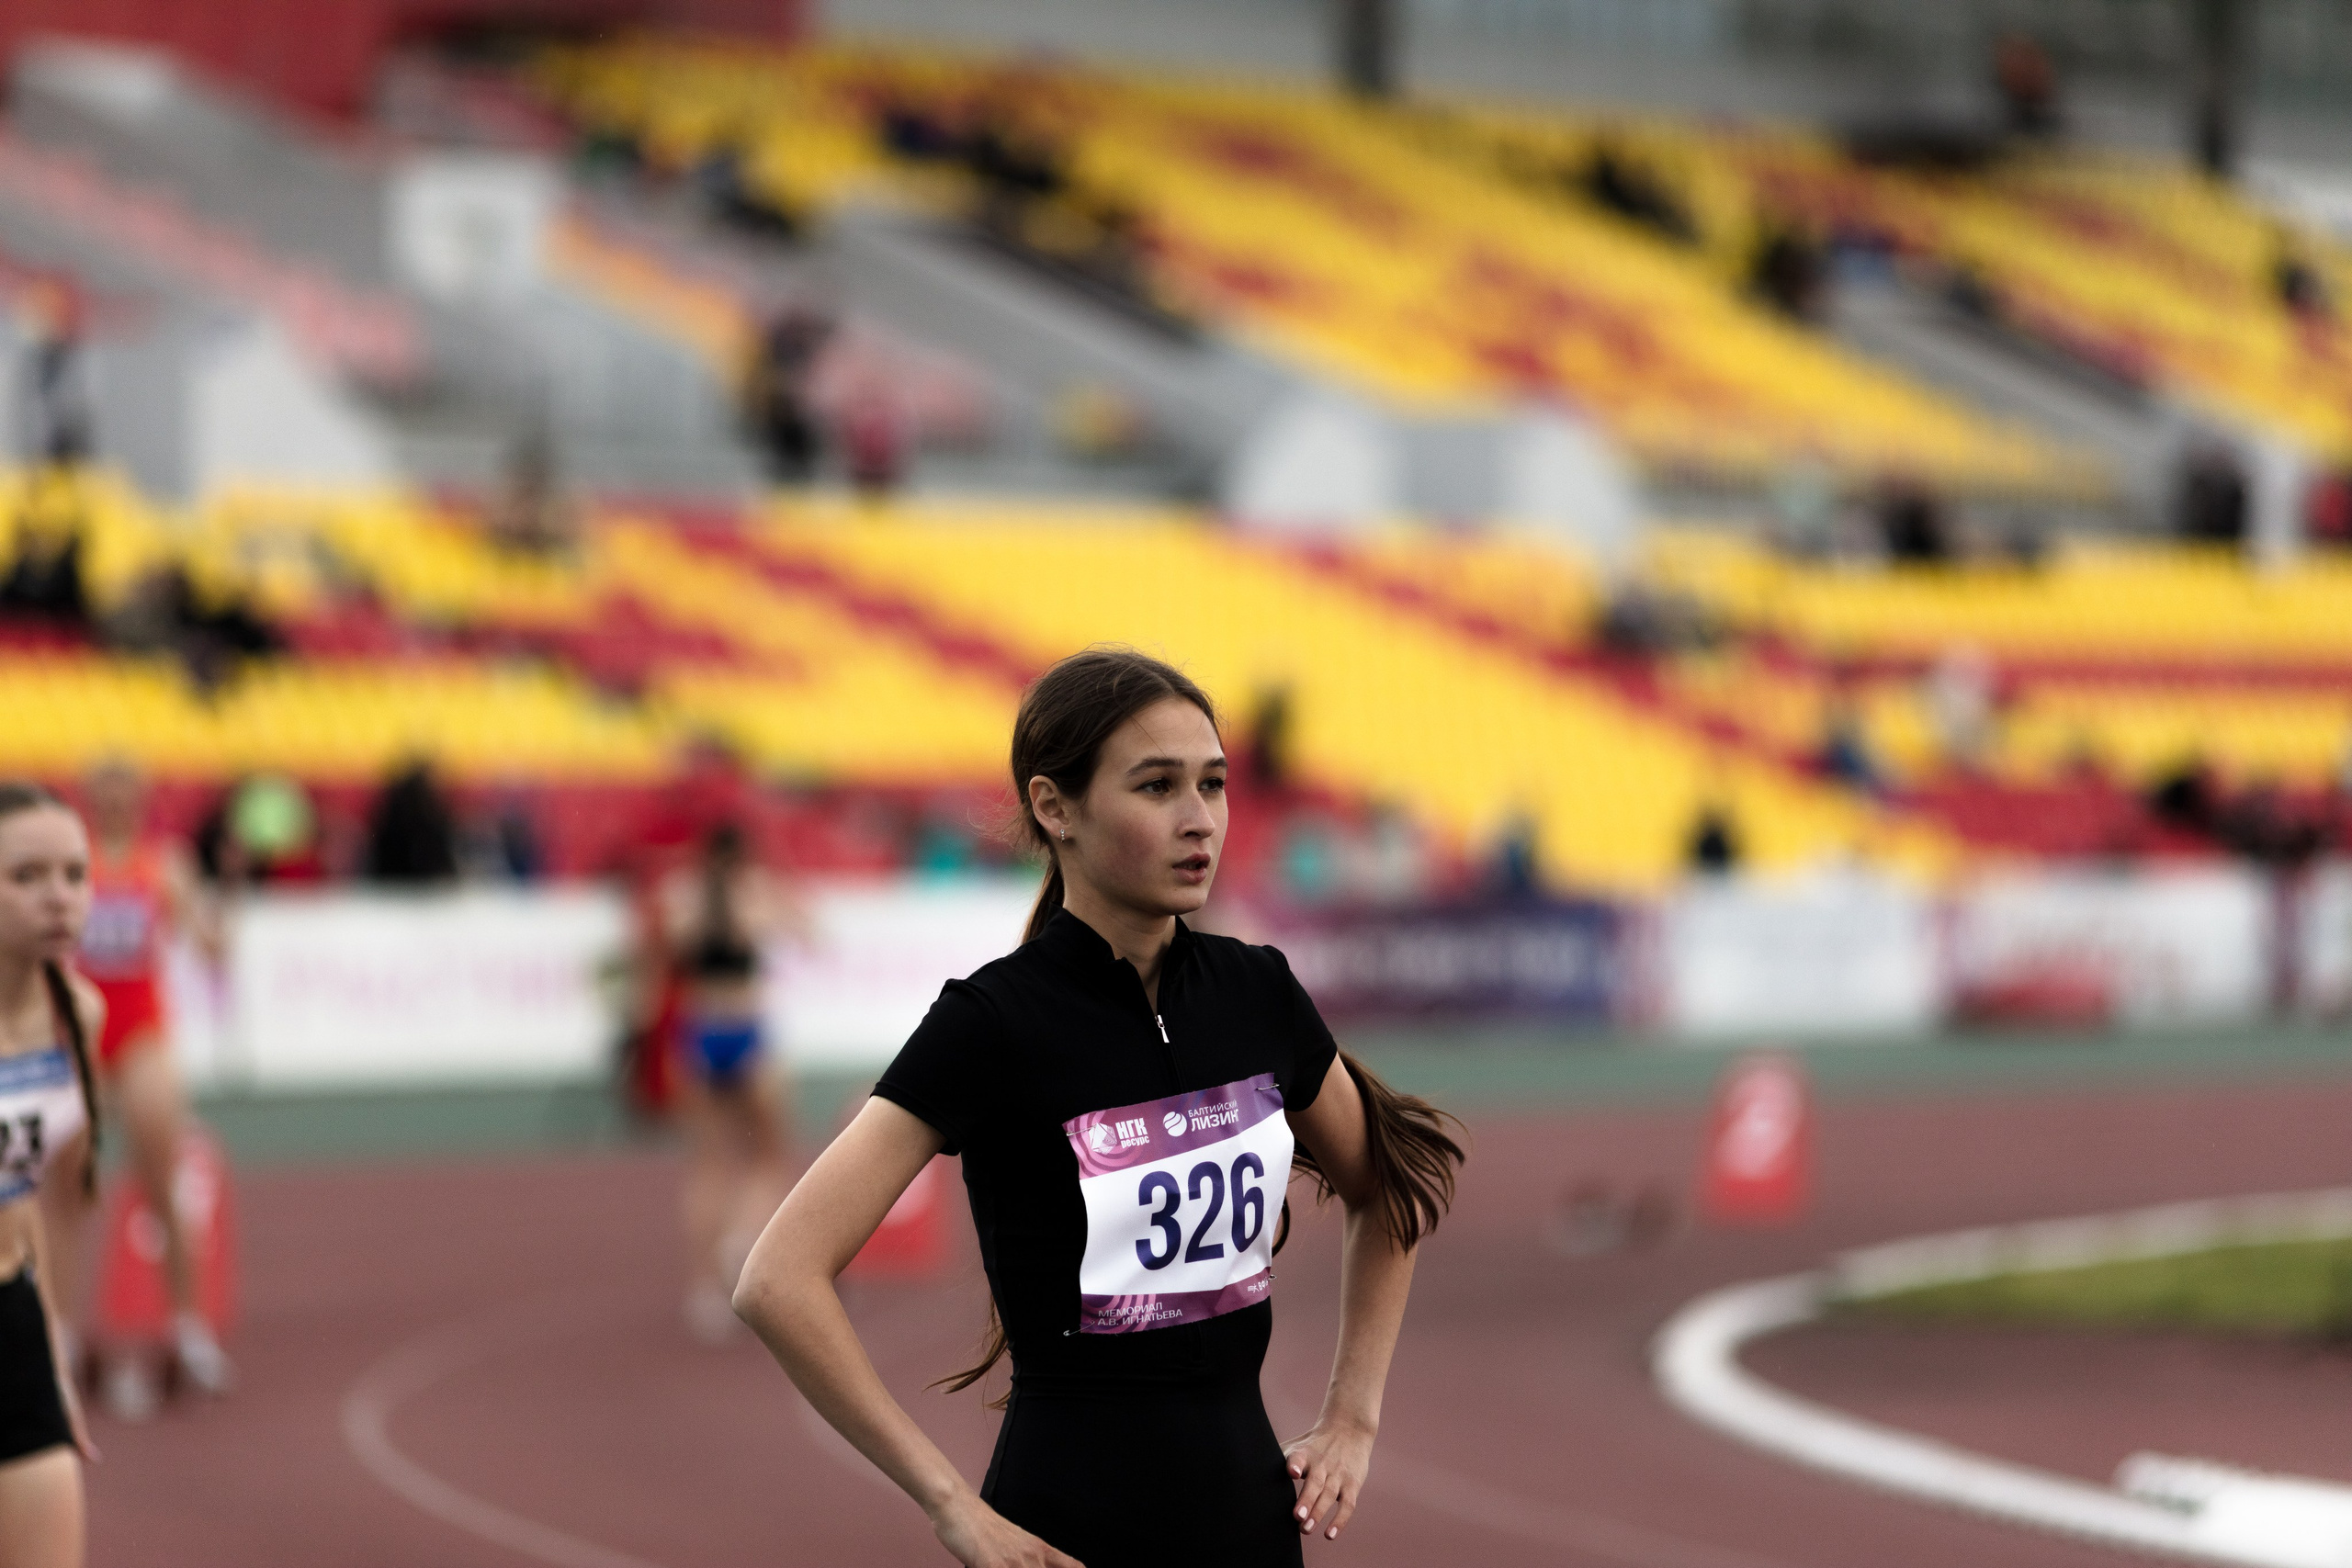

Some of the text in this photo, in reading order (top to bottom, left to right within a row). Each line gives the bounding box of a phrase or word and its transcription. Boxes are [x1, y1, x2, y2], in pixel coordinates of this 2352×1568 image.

[1114, 1117, 1148, 1140] НГК
[1120, 1135, 1150, 1149] ресурс
[1135, 1151, 1265, 1271] 326
[1097, 1309, 1183, 1326] А.В. ИГНАТЬЕВА
[1098, 1302, 1163, 1317] МЕМОРИАЛ
